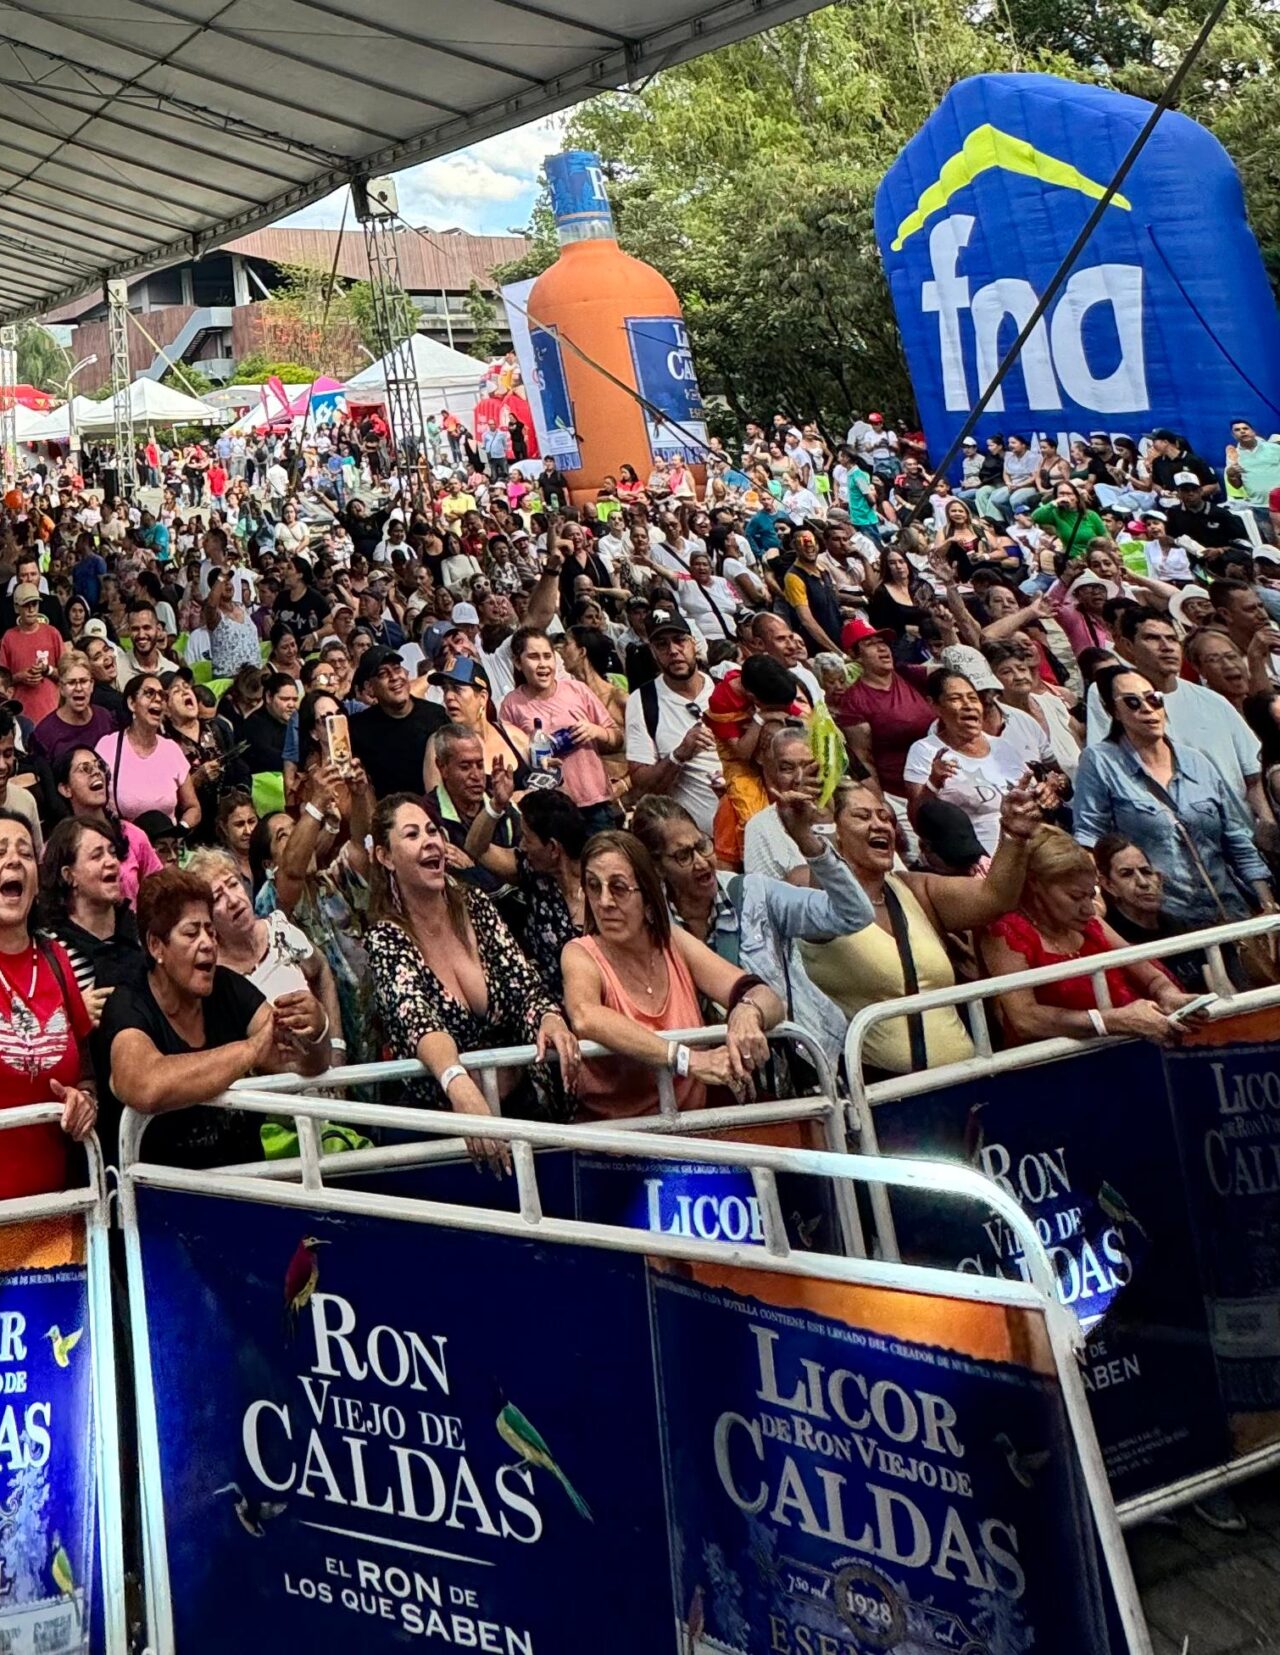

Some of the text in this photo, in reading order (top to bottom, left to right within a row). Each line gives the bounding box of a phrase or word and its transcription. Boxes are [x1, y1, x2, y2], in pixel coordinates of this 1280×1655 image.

[922, 214, 1150, 415] fna
[981, 1143, 1071, 1206] RON
[983, 1207, 1085, 1260] VIO DE
[311, 1292, 449, 1395] RON
[1080, 1353, 1142, 1393] ABEN
[297, 1375, 466, 1451] VIEJO DE
[749, 1324, 965, 1458] LICOR
[243, 1400, 543, 1543] CALDAS
[714, 1411, 1025, 1600] CALDAS
[284, 1573, 533, 1655] LOS QUE SABEN
[326, 1557, 479, 1608] EL RON DE
[845, 1589, 892, 1625] 1928
